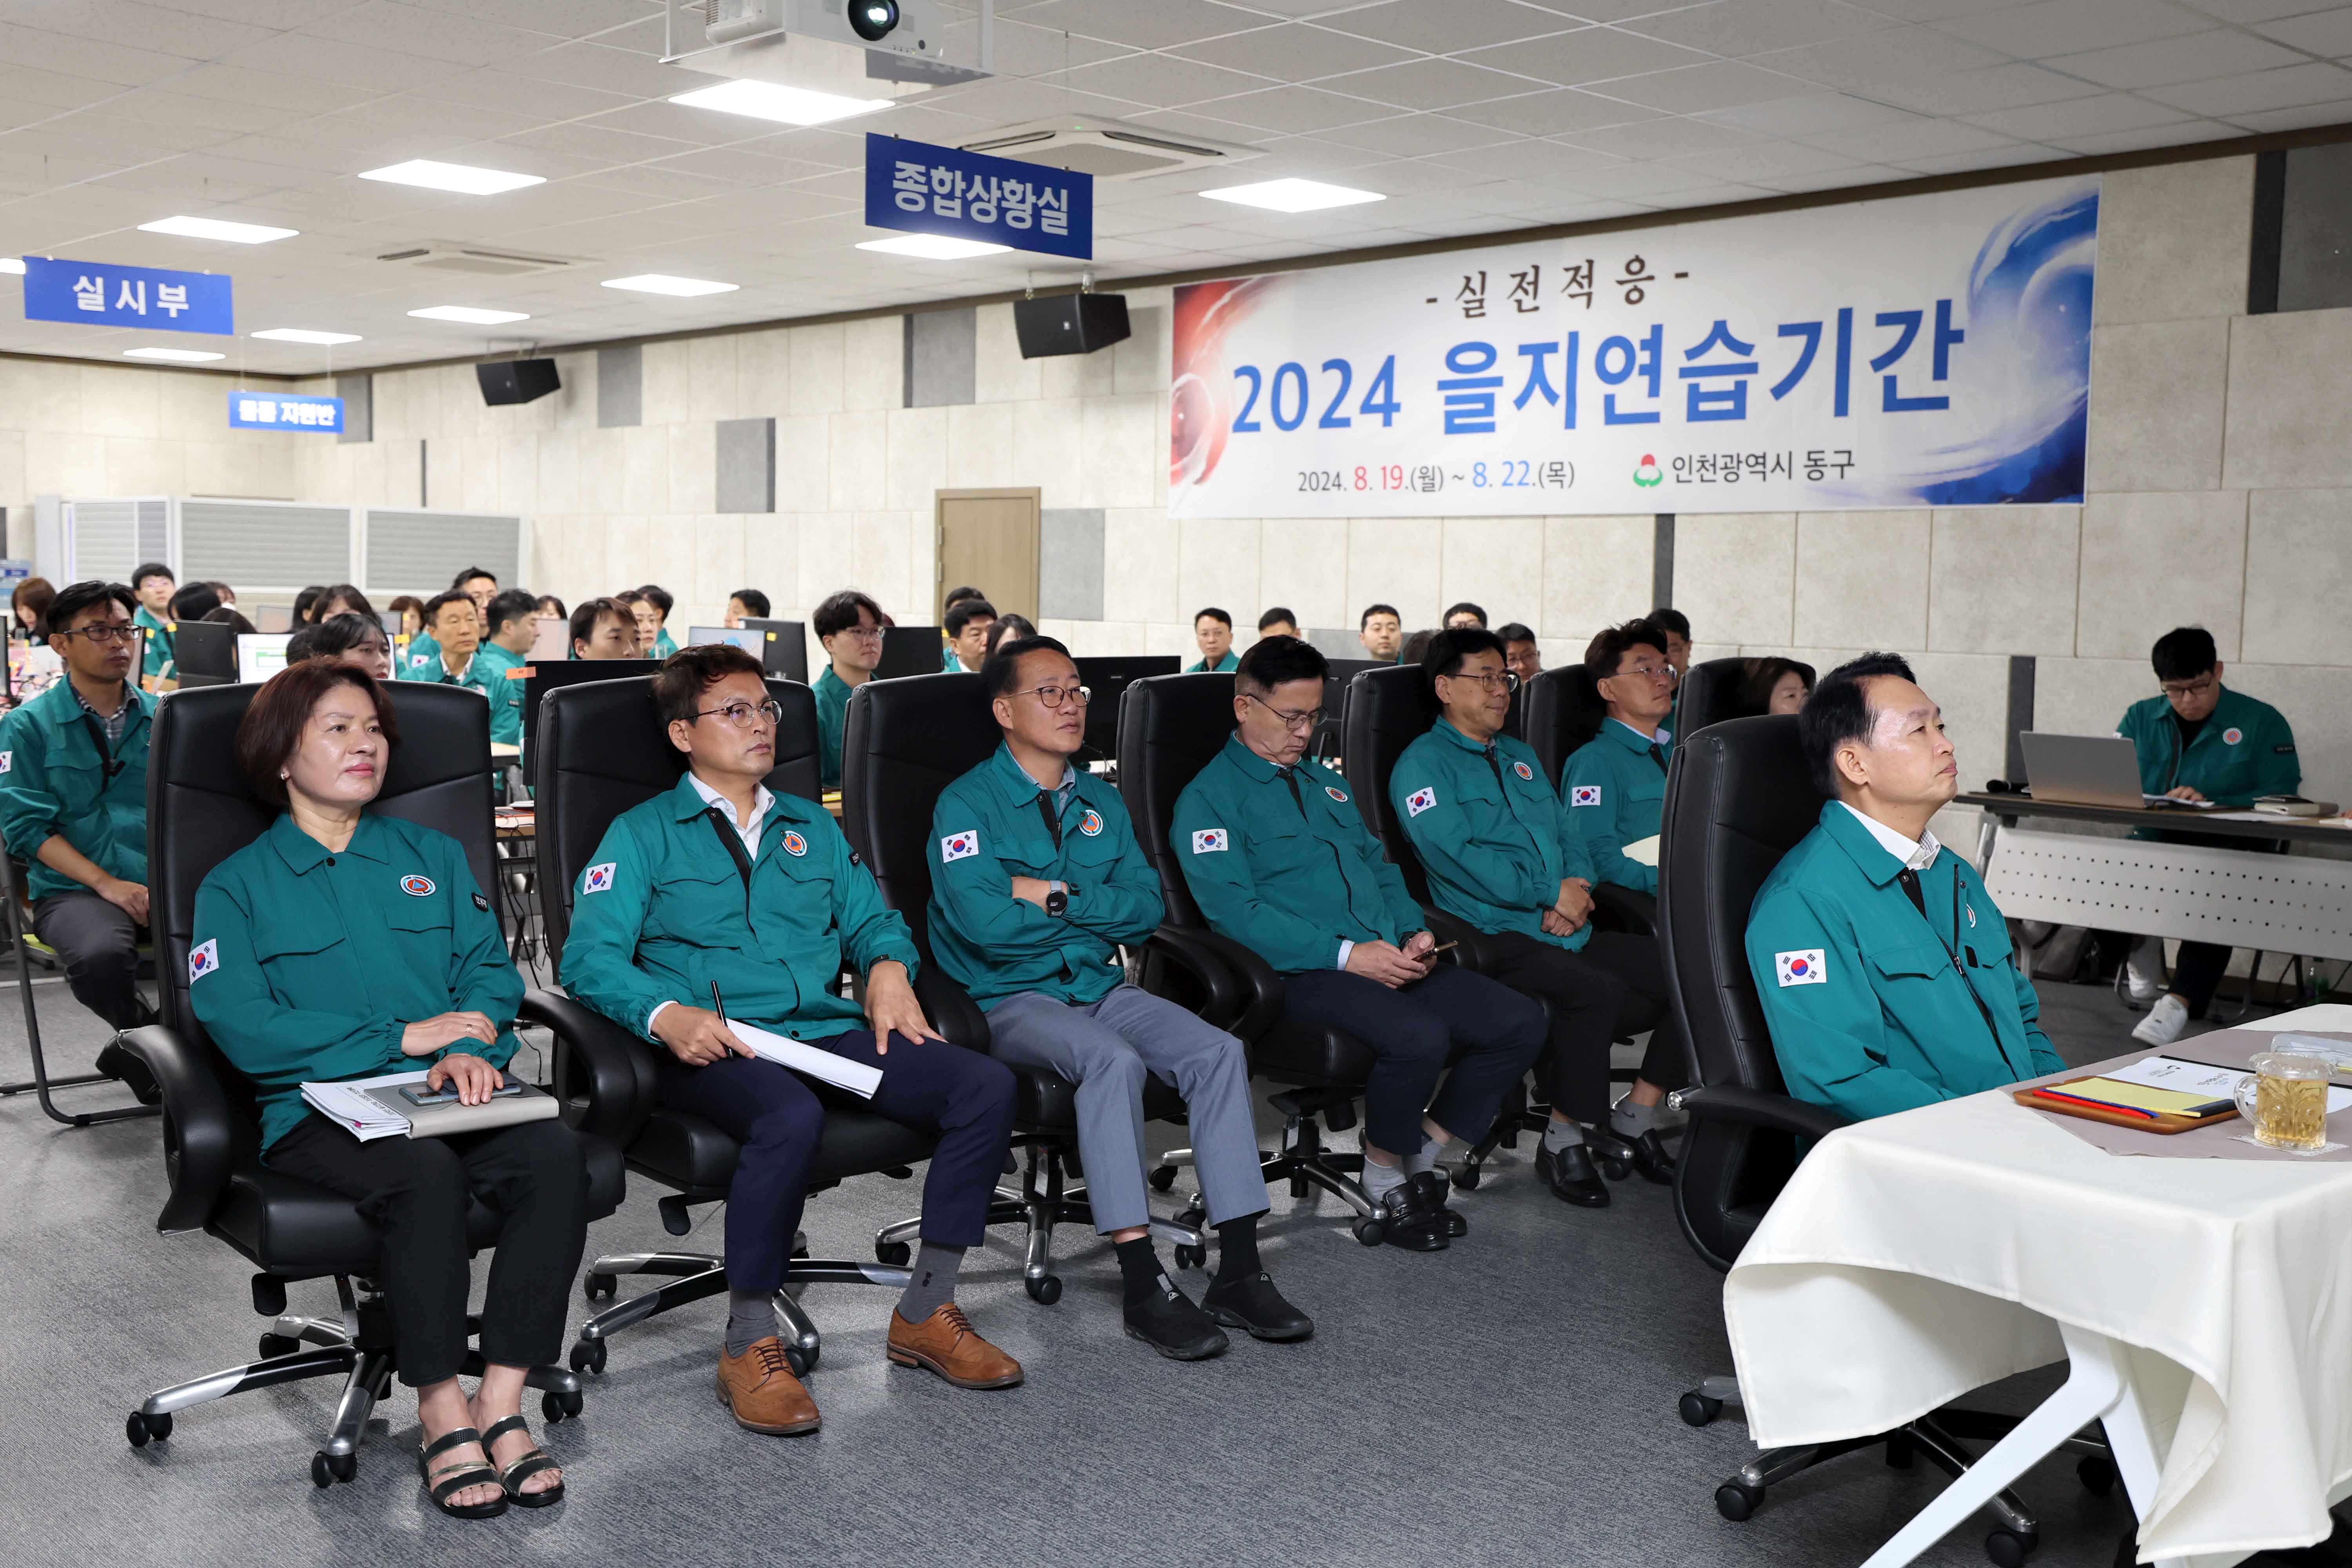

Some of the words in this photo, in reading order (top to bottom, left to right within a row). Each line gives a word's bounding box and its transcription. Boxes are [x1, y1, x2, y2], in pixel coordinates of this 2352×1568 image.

[892, 161, 1068, 236] 종합상황실
[73, 275, 190, 318] 실시부
[1232, 355, 1401, 433] 2024
[1299, 472, 1347, 492] 2024.
[1672, 450, 1792, 483] 인천광역시
[1803, 450, 1855, 481] 동구
